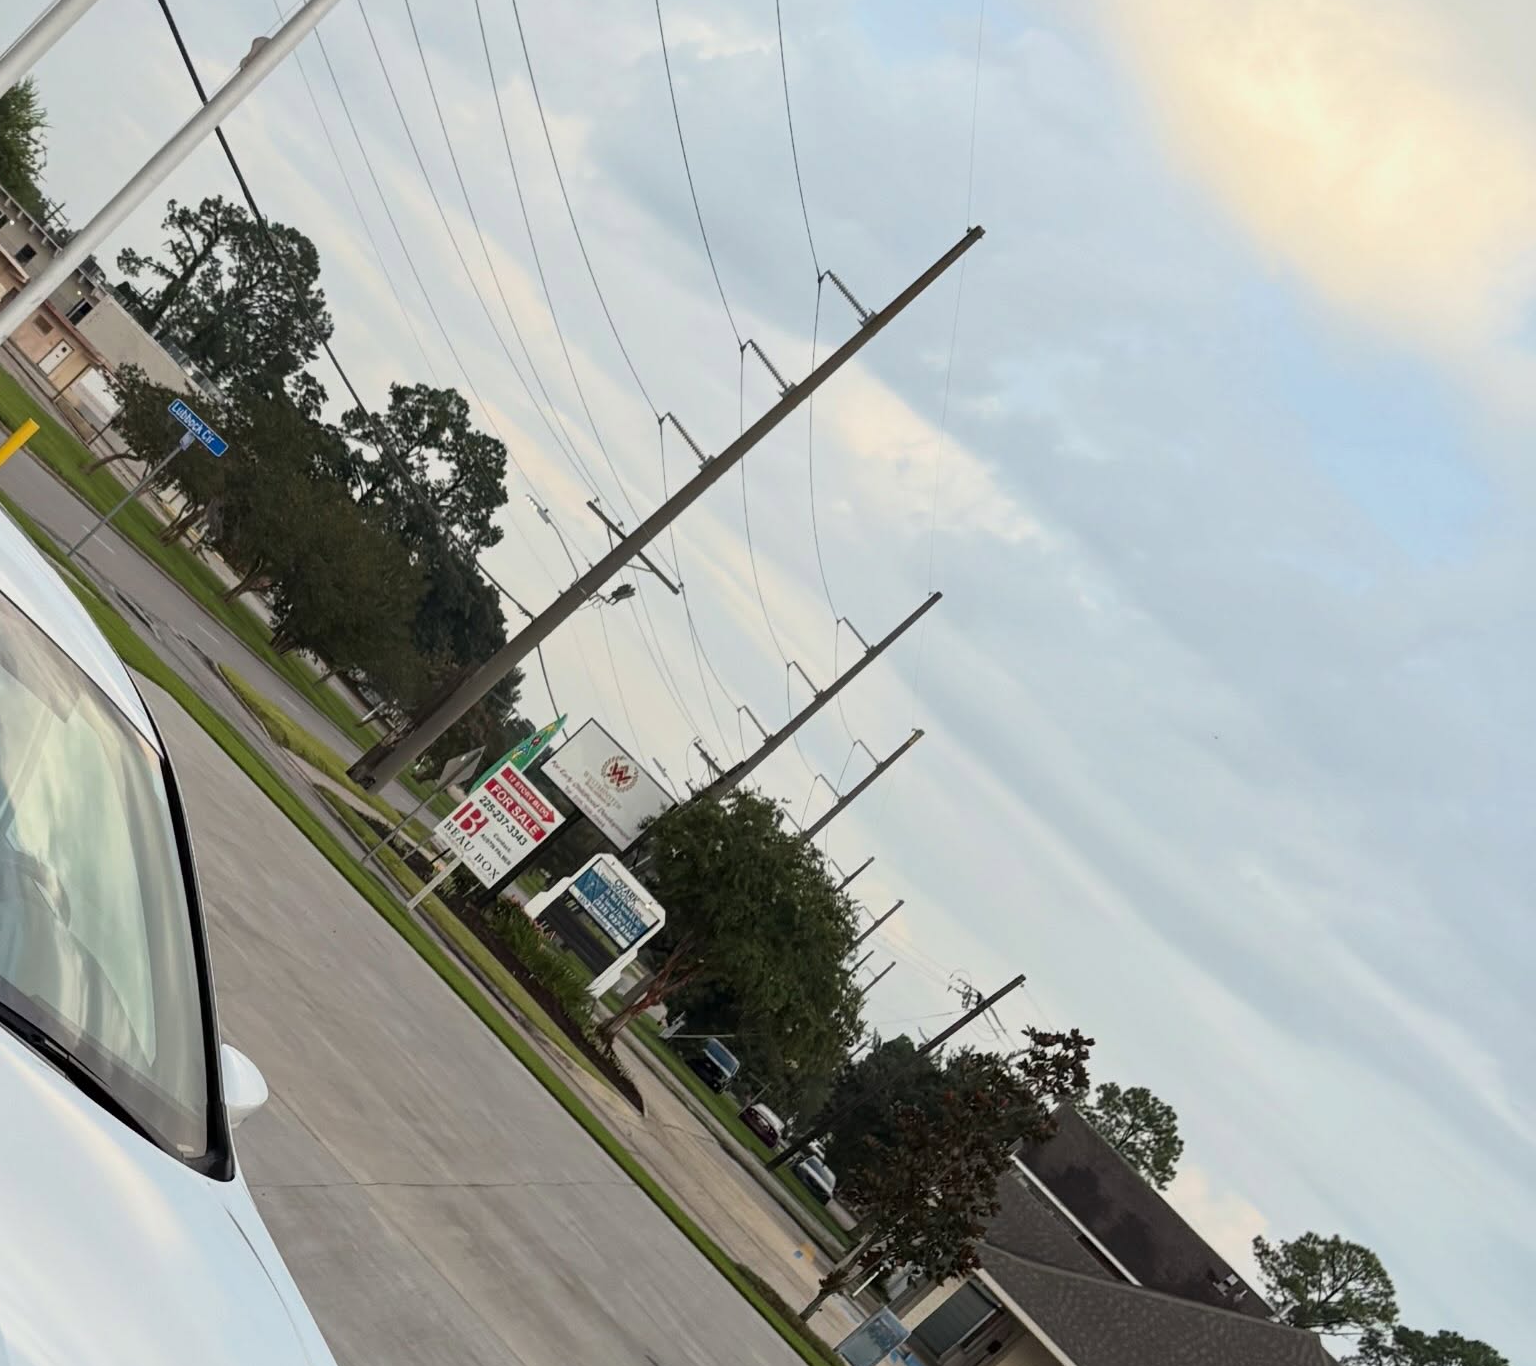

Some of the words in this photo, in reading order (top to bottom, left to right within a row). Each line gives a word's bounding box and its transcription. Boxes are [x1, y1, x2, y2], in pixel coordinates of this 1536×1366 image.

[171, 401, 203, 434] Lubbock
[200, 429, 215, 443] Cir
[477, 794, 529, 846] 225-237-3343
[489, 783, 514, 808] FOR
[509, 804, 541, 836] SALE
[442, 820, 475, 853] BEAU
[472, 852, 500, 880] BOX
